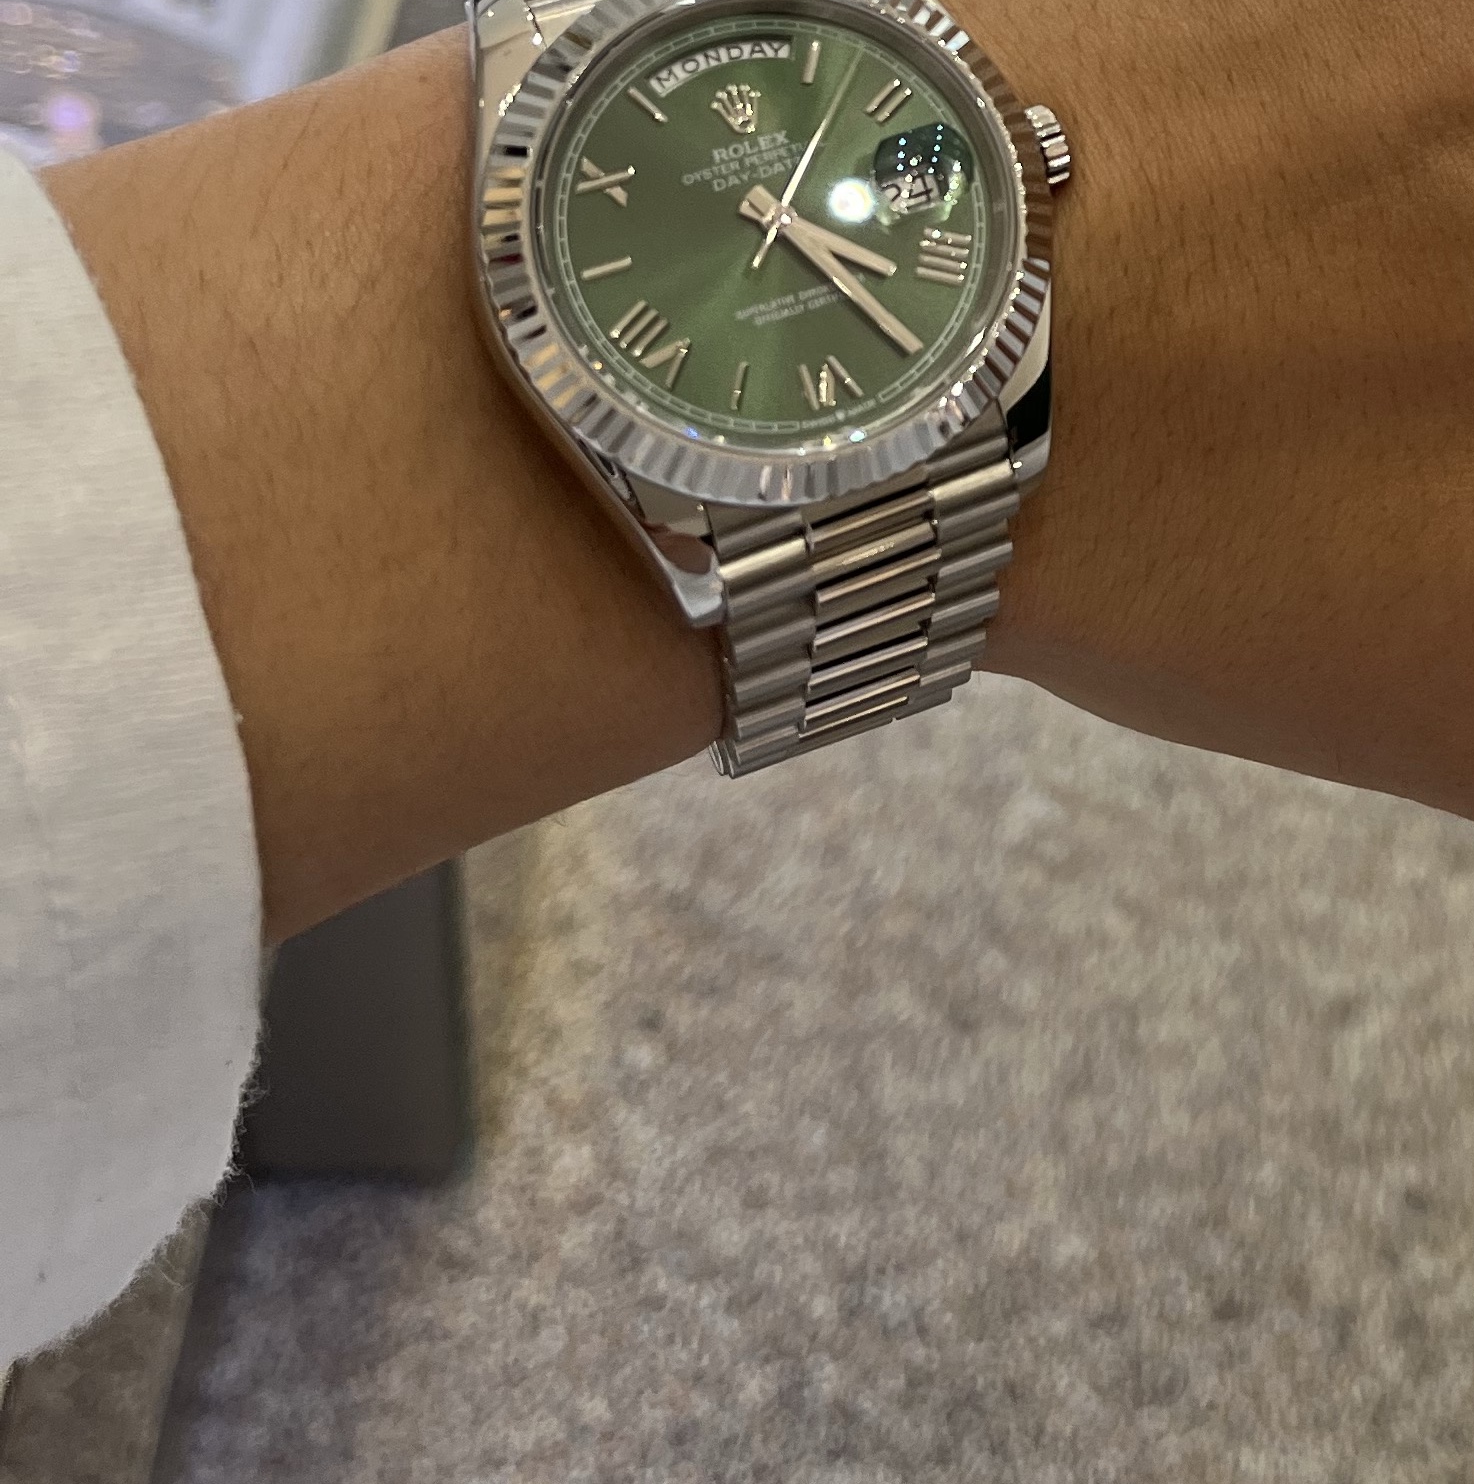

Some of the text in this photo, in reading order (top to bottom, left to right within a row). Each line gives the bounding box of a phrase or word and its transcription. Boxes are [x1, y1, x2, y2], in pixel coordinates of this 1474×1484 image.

[655, 41, 787, 89] MONDAY
[711, 130, 789, 164] ROLEX
[681, 160, 740, 186] OYSTER
